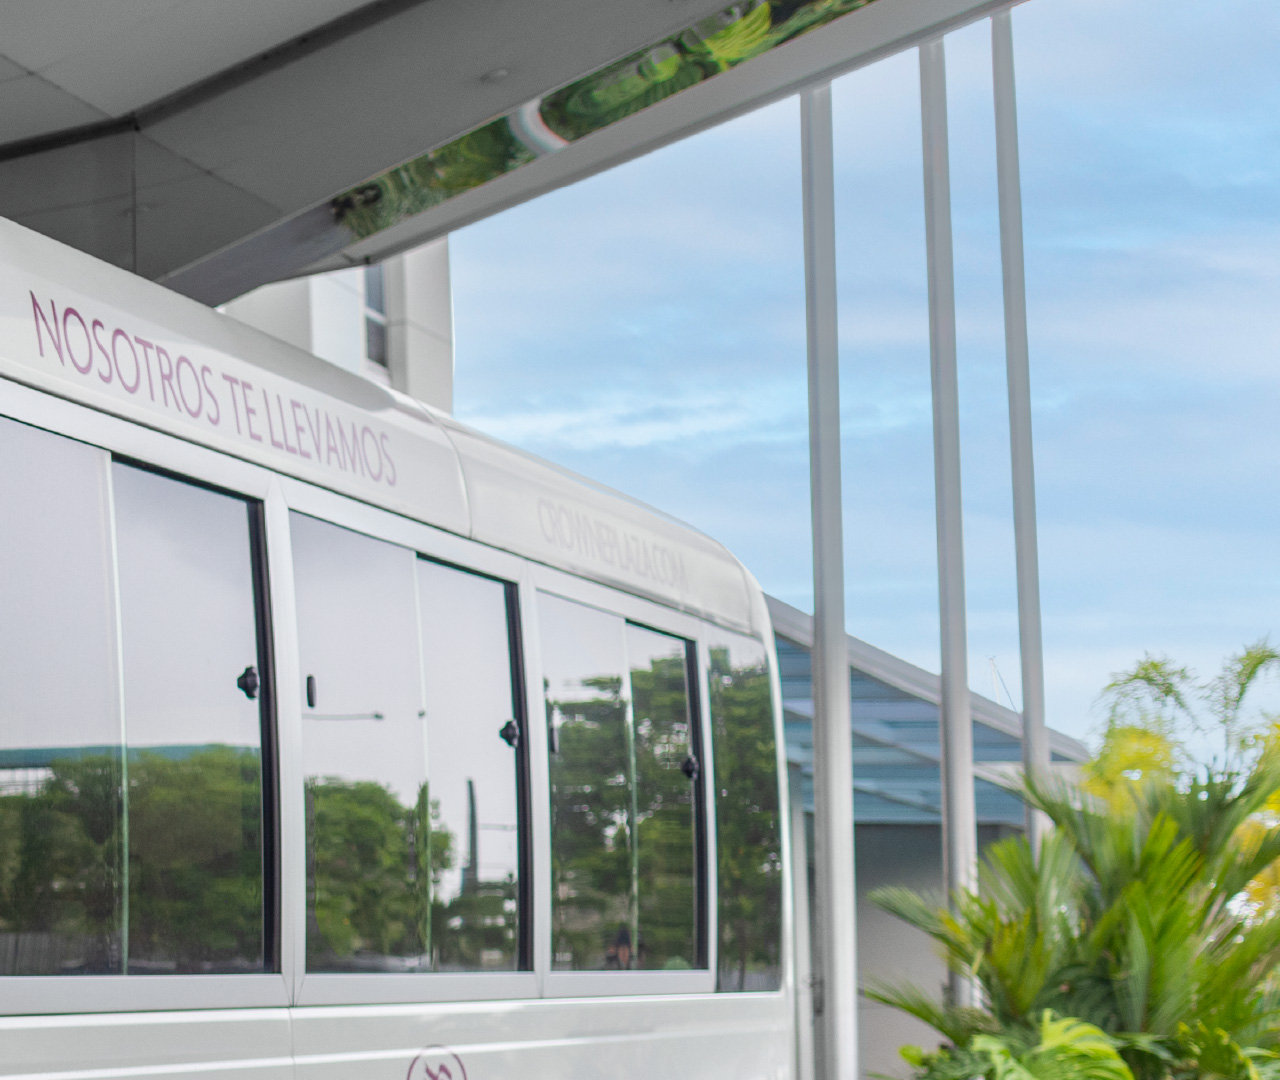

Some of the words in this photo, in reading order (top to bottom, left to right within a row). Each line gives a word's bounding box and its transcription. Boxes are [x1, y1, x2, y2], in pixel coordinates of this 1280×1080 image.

[29, 290, 220, 426] NOSOTROS
[222, 372, 263, 443] TE
[261, 388, 397, 487] LLEVAMOS
